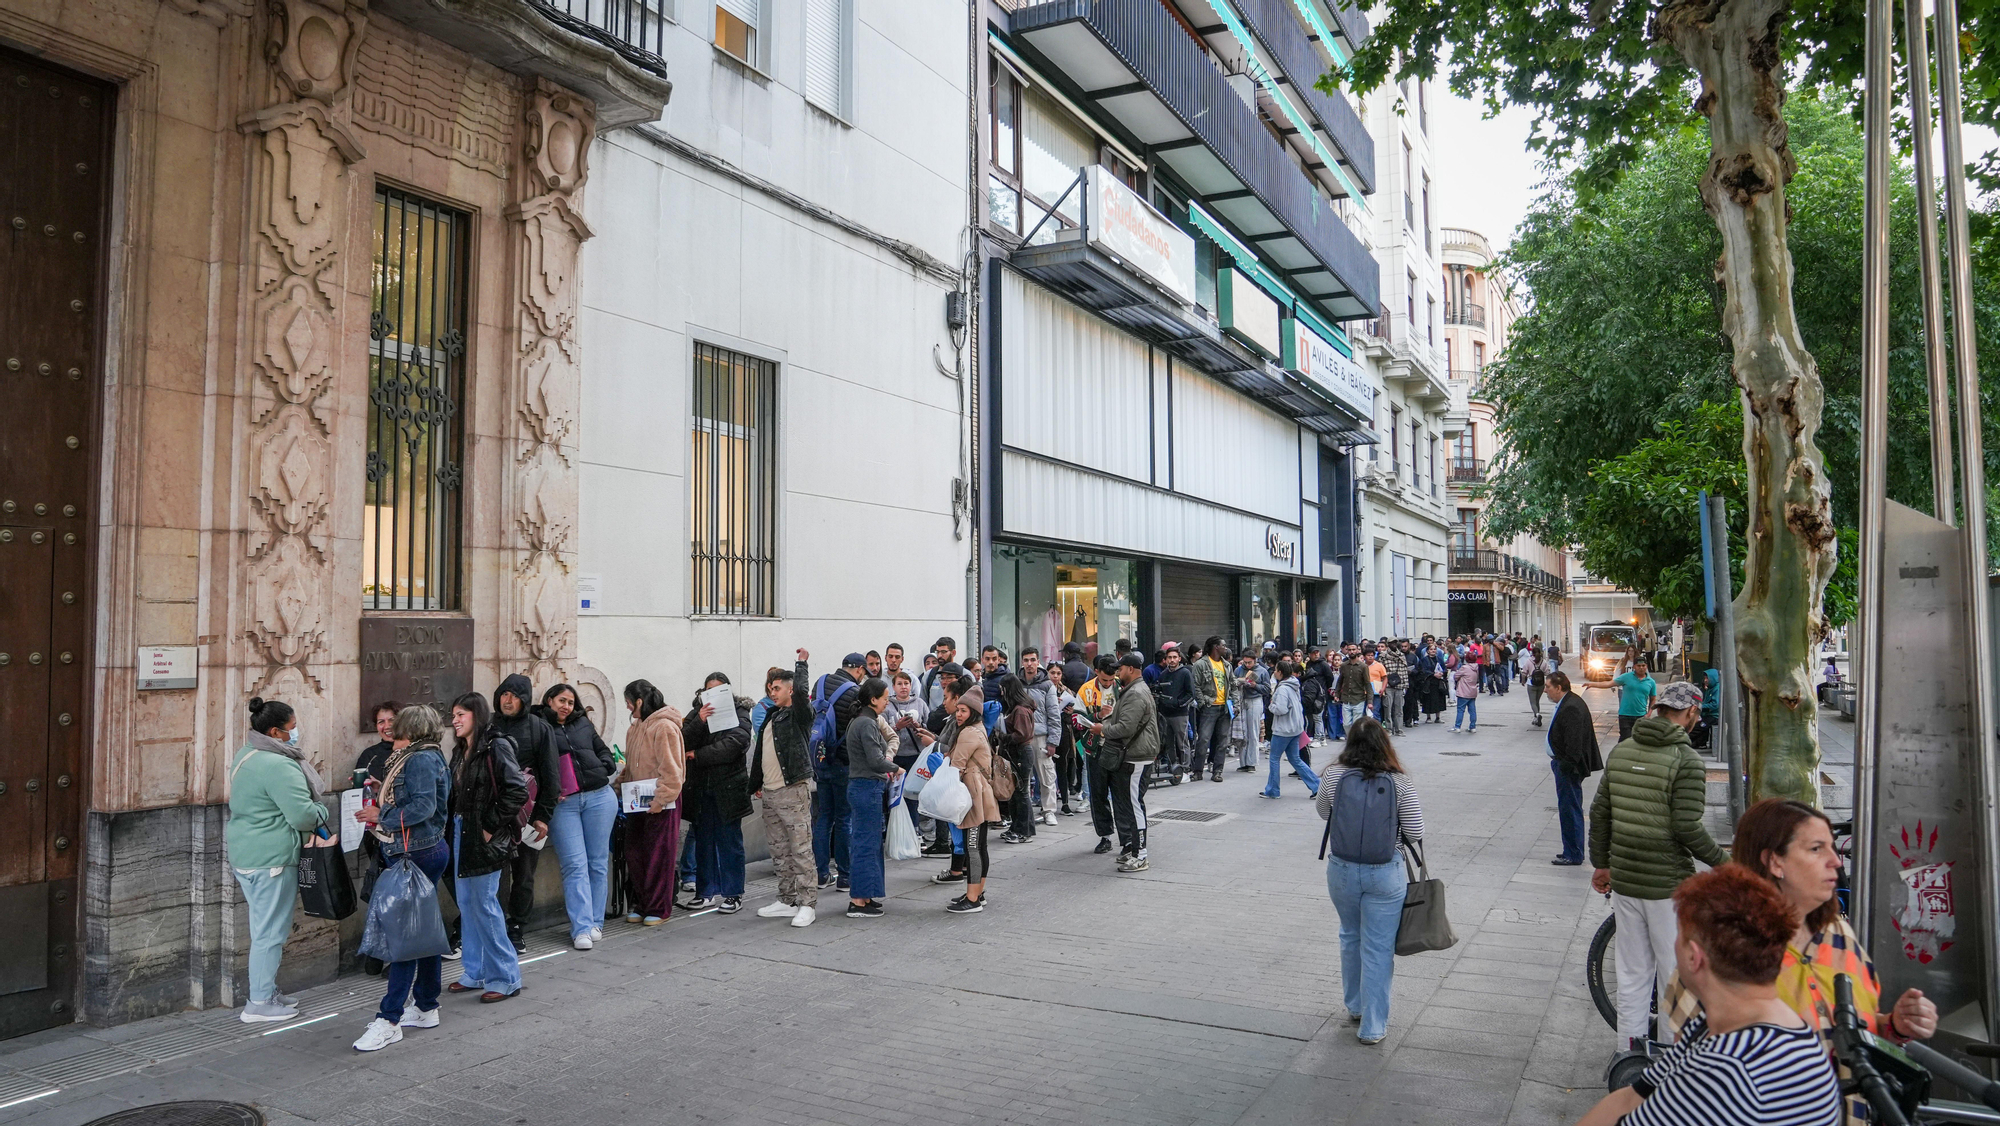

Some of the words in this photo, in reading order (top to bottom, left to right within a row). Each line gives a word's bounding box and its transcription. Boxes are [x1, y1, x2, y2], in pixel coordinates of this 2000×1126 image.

[1105, 187, 1170, 260] Ciudadanos
[1312, 345, 1338, 377] AVILÉS
[1341, 366, 1346, 382] &
[1448, 592, 1466, 601] OSA
[1467, 591, 1488, 601] CLARÁ
[395, 625, 445, 645] EXCMO
[363, 650, 473, 671] AYUNTAMIENTO
[410, 675, 432, 696] DE
[969, 827, 978, 849] ORKOUT
